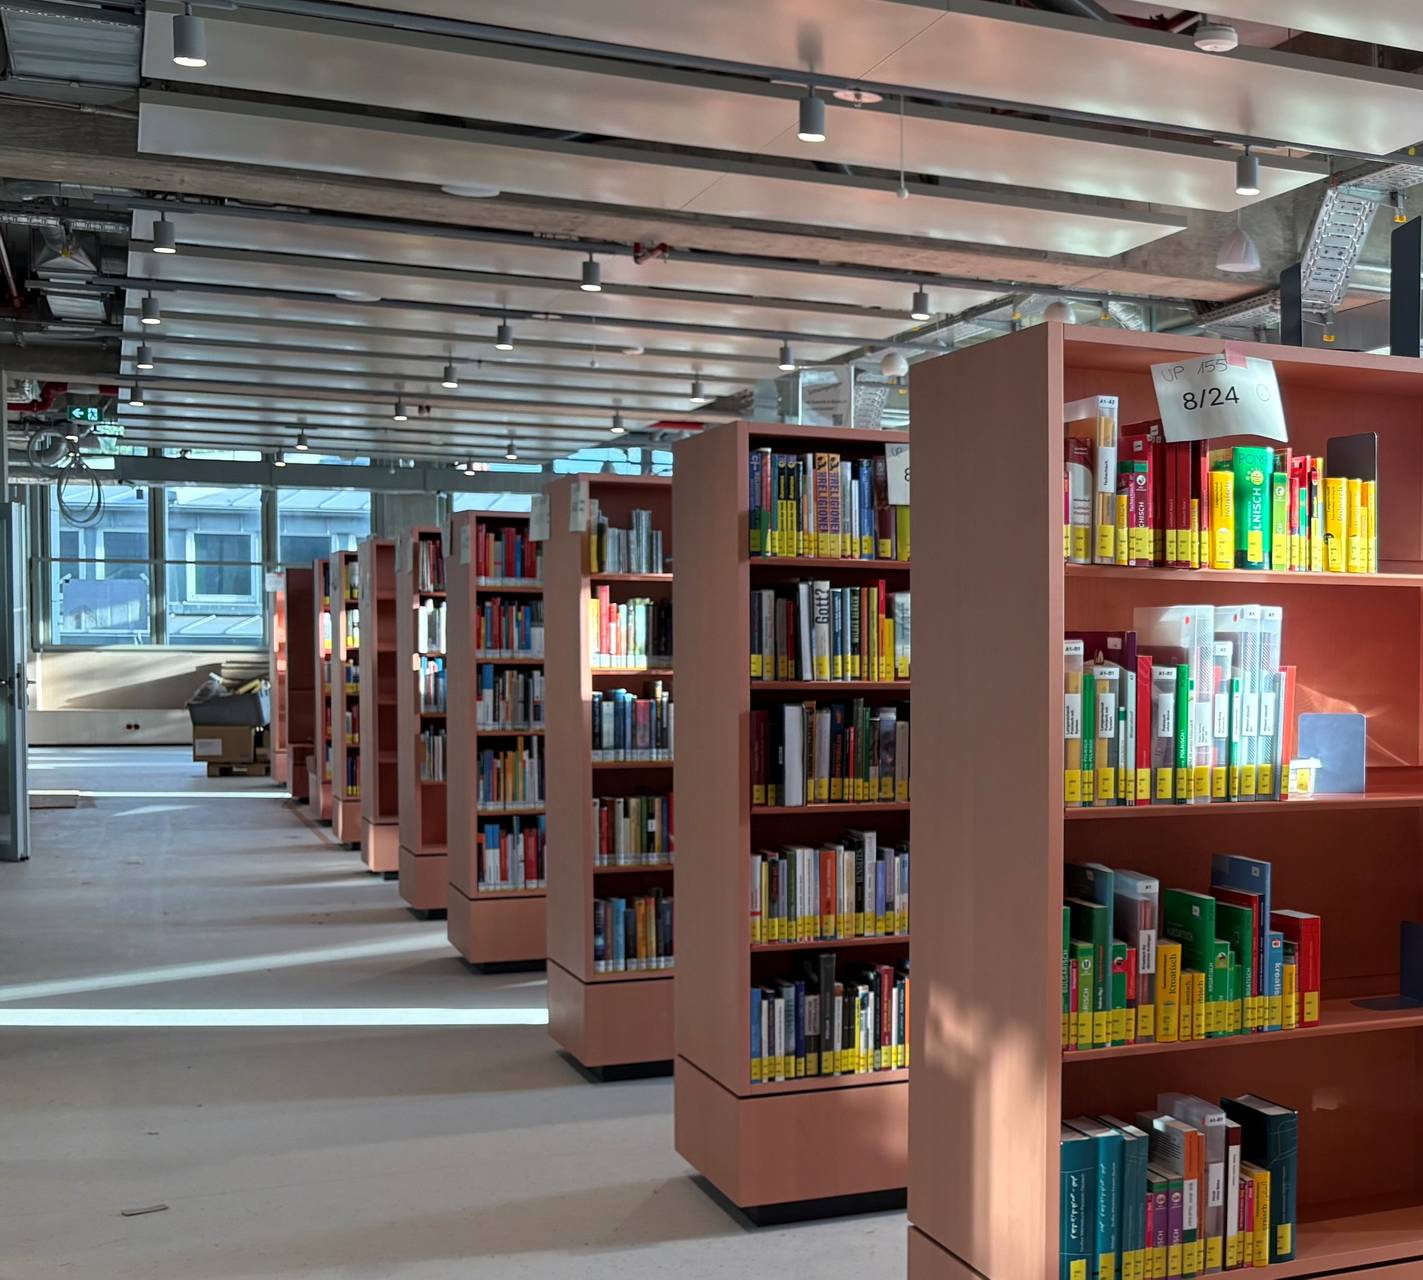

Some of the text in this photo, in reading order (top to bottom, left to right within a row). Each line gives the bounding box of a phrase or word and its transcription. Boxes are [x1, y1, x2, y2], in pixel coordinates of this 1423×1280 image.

[1160, 365, 1185, 383] UP
[1182, 386, 1240, 411] 8/24
[1252, 488, 1262, 530] LNISCH
[814, 588, 830, 624] Gott?
[1168, 953, 1176, 994] Kroatisch
